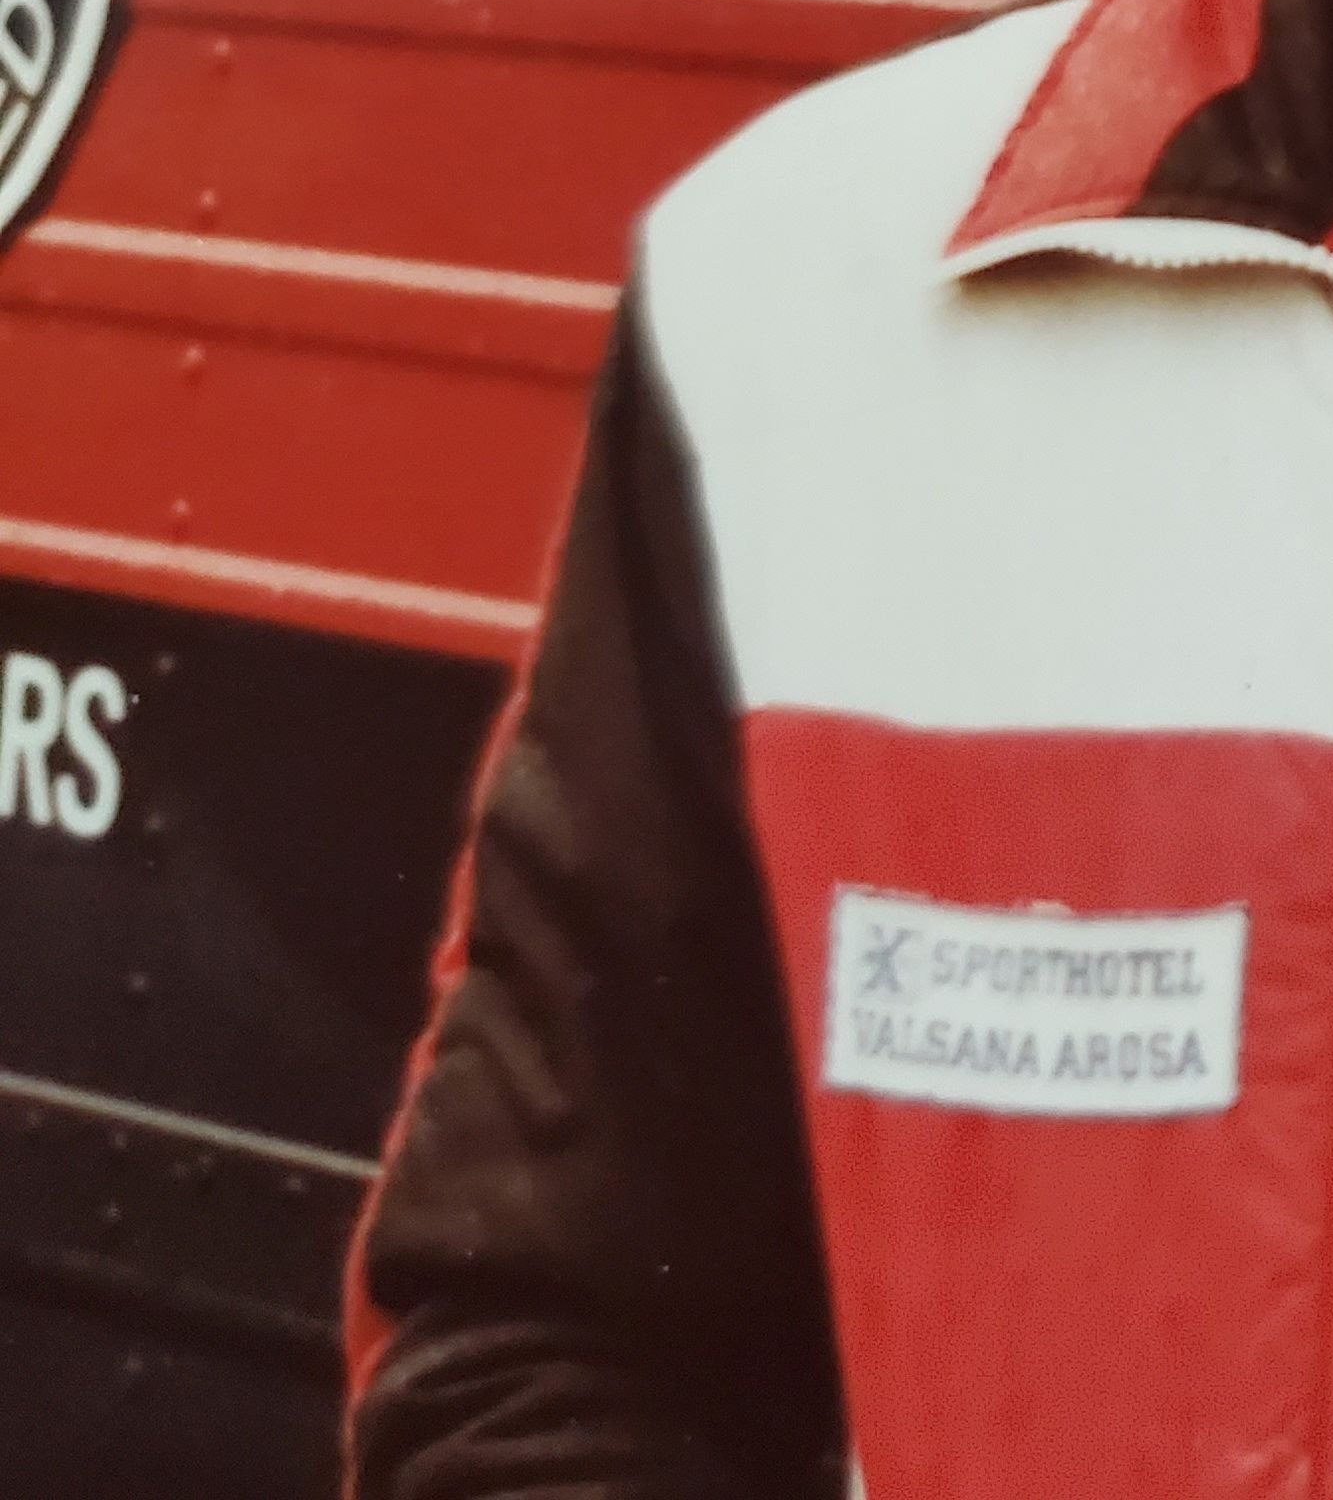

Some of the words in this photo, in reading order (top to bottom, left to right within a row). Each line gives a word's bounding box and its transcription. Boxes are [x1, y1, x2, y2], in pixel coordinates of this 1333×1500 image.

[930, 937, 1206, 999] SPORTHOTEL
[851, 1005, 1041, 1079] VALSANA
[1051, 1028, 1210, 1081] AROSA
